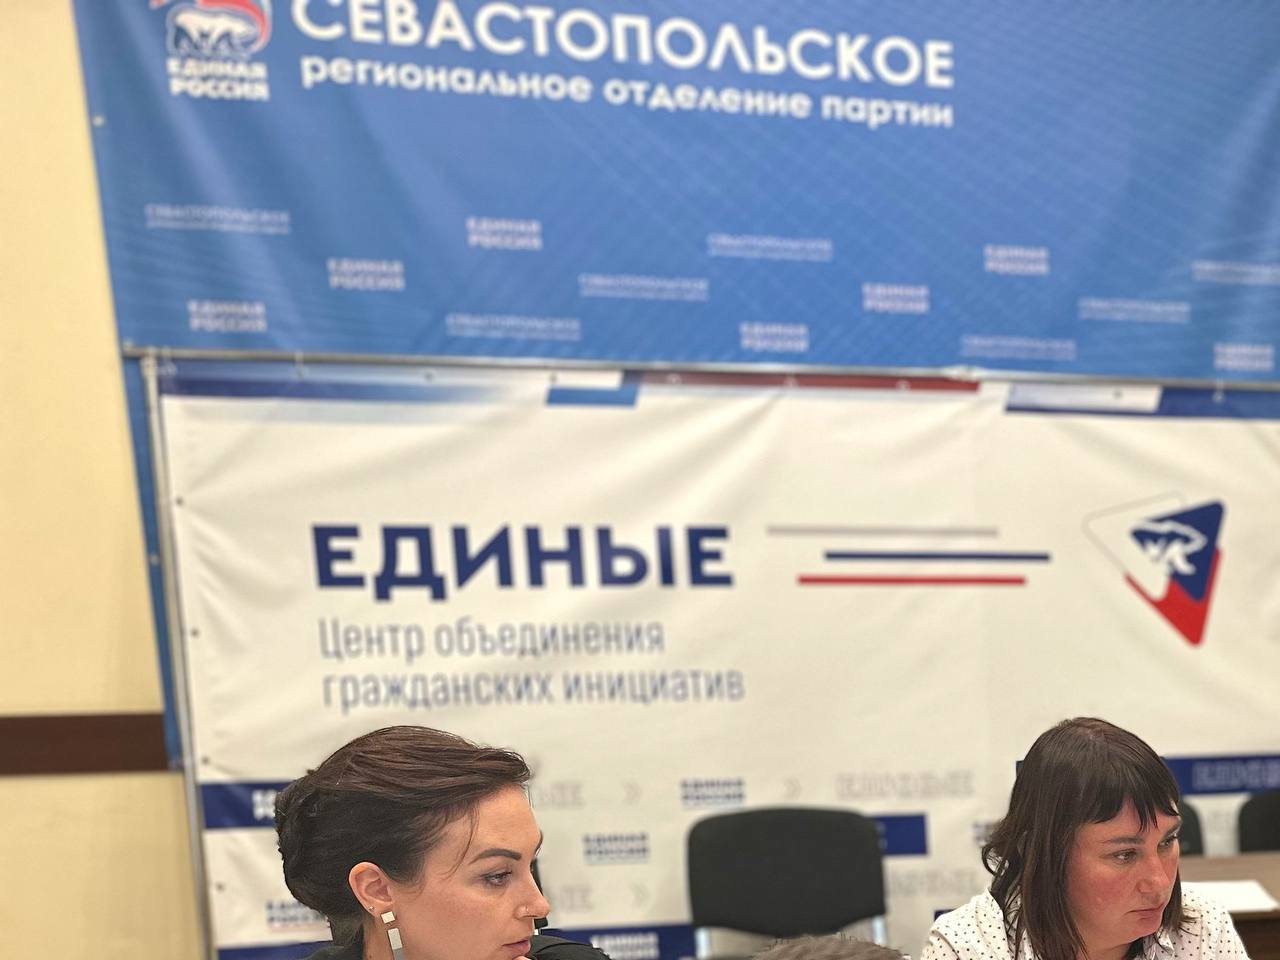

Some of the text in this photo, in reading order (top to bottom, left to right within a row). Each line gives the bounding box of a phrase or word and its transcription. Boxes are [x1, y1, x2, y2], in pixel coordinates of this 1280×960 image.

[166, 57, 268, 78] ЕДИНАЯ
[291, 0, 954, 88] СЕВАСТОПОЛЬСКОЕ
[169, 78, 270, 100] РОССИЯ
[301, 55, 953, 129] региональное отделение партии
[312, 523, 734, 602] ЕДИНЫЕ
[319, 615, 665, 664] Центр объединения
[322, 667, 746, 716] гражданских инициатив
